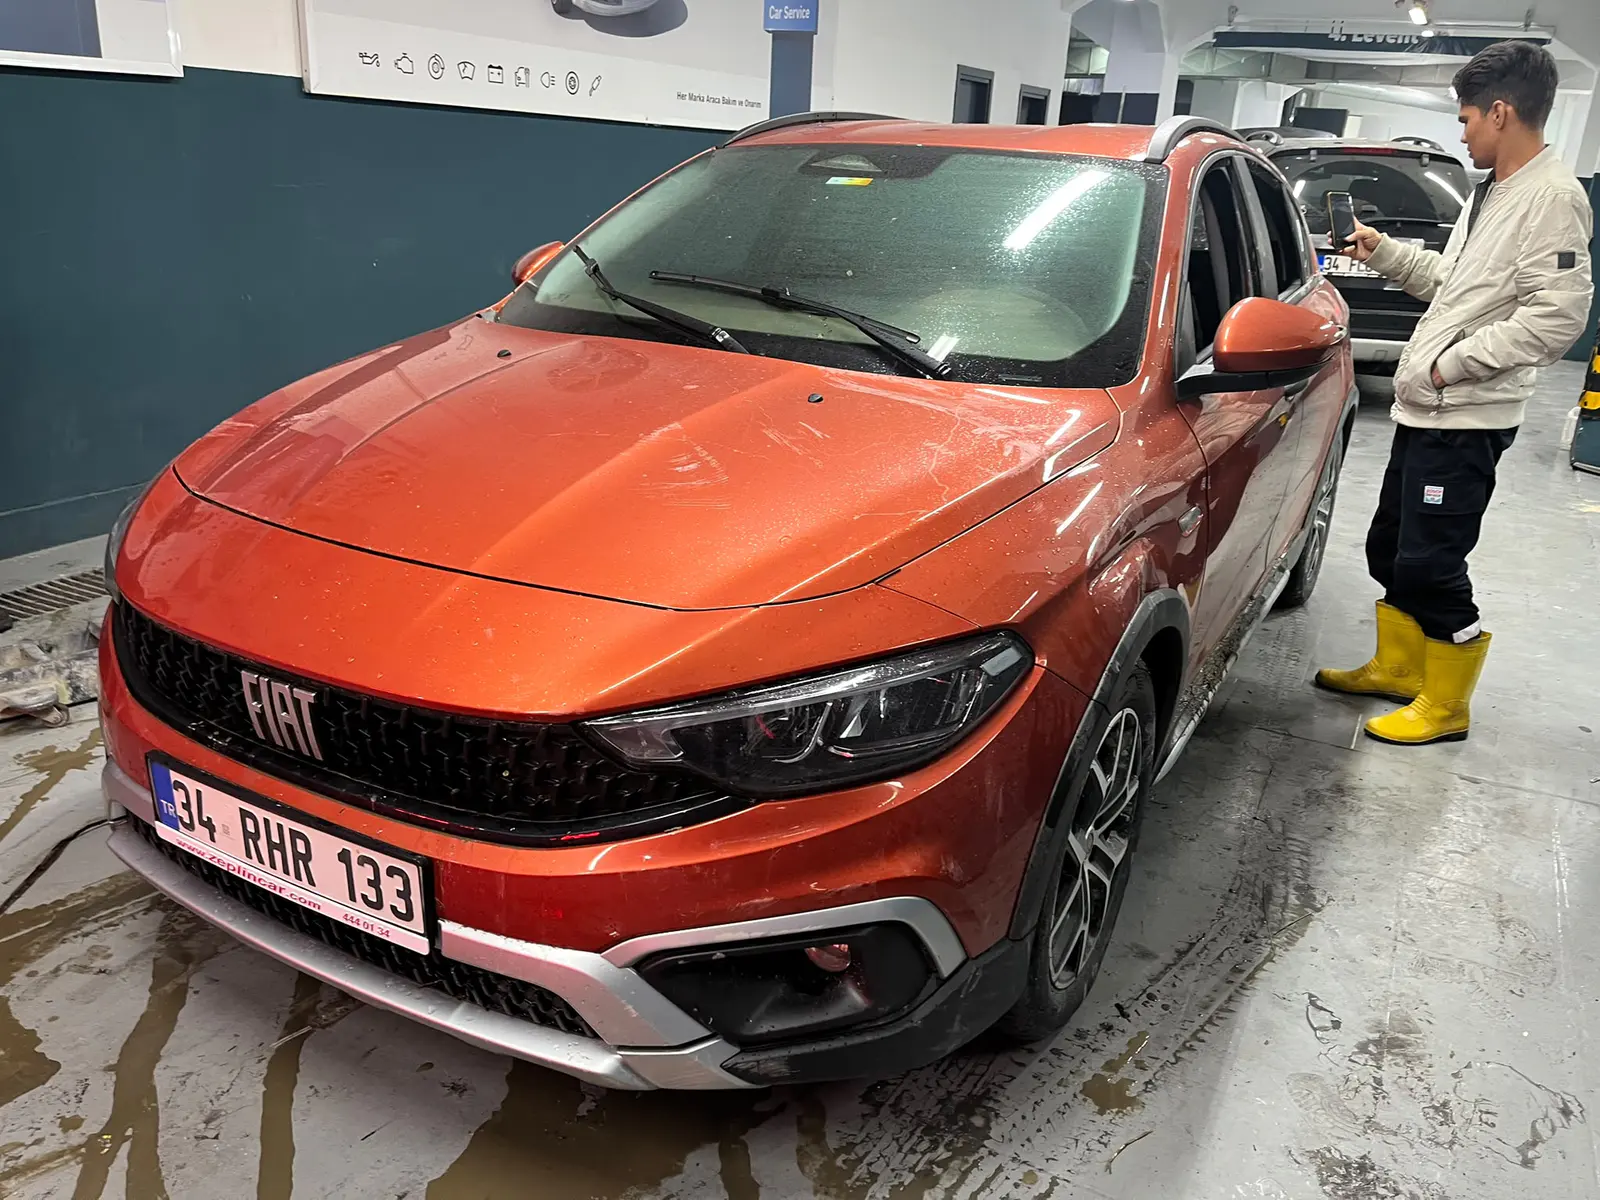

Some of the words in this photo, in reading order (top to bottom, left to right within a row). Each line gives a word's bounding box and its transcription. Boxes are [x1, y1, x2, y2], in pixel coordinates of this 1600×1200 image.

[769, 5, 782, 19] Car
[784, 4, 810, 19] Service
[677, 91, 687, 100] Her
[688, 92, 705, 103] Marka
[706, 94, 720, 104] Araca
[1324, 256, 1340, 271] 34
[241, 670, 324, 761] FIAT
[160, 799, 177, 818] TR
[173, 780, 217, 843] 34
[239, 806, 317, 887] RHR
[337, 847, 415, 922] 133
[175, 838, 322, 911] www.zeplincar.com
[342, 913, 361, 926] 444
[363, 921, 375, 932] 01
[377, 926, 390, 938] 34
